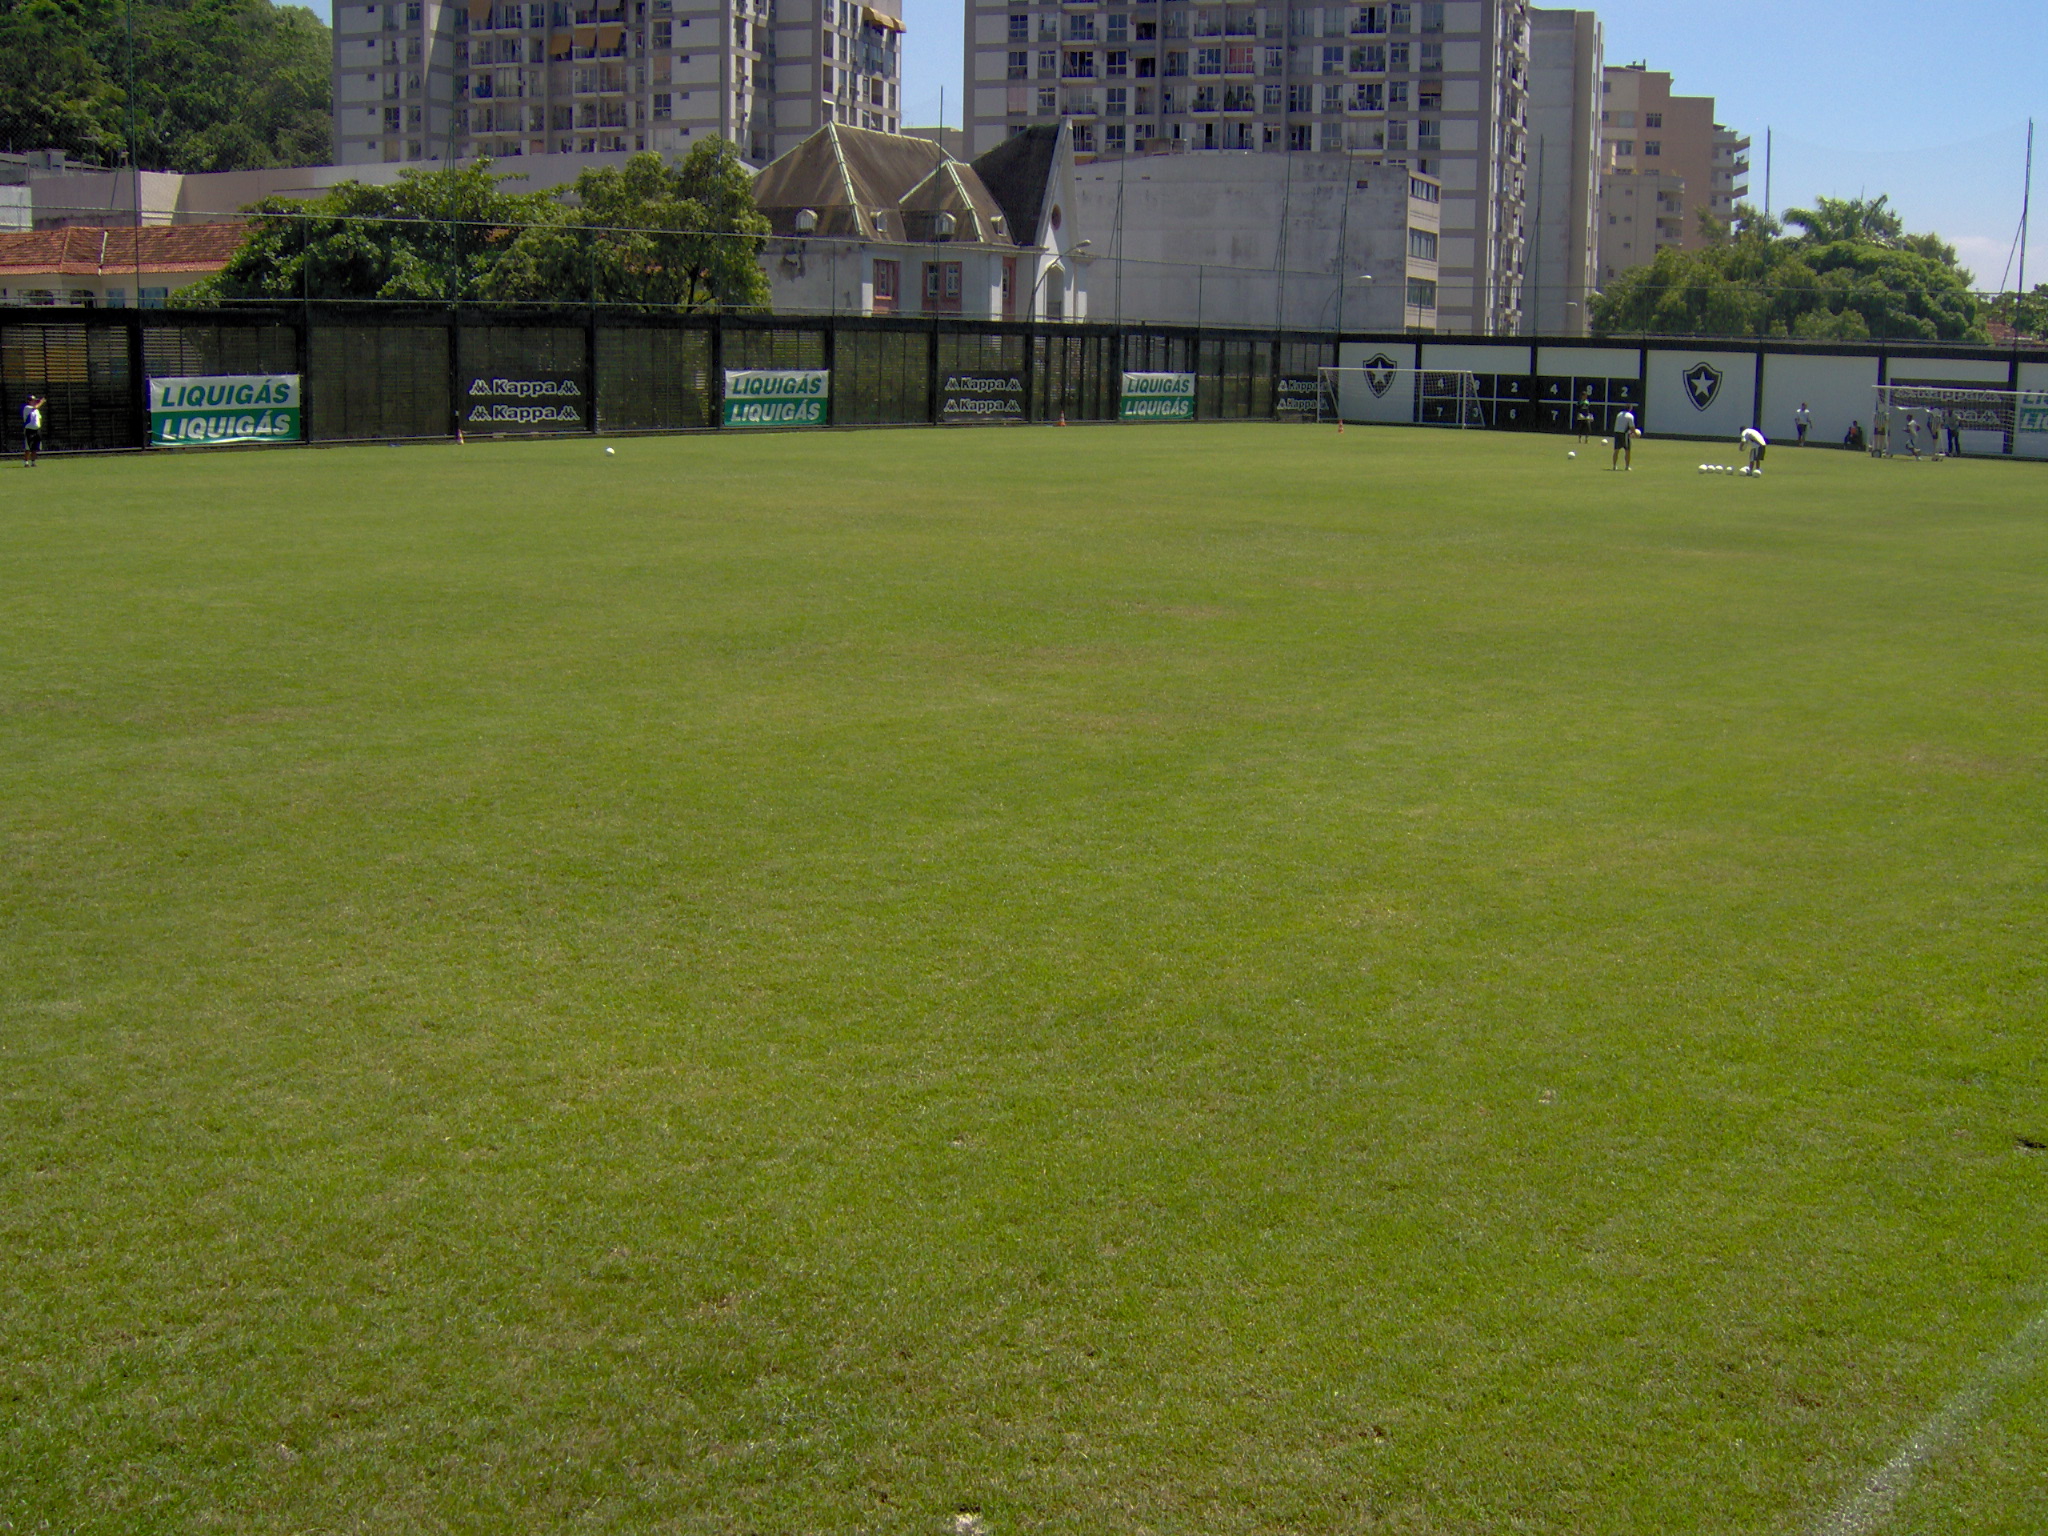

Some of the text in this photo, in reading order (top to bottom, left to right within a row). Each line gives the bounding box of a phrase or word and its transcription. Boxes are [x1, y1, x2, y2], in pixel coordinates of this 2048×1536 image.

[161, 379, 290, 407] LIQUIGÁS
[493, 379, 557, 397] Kappa
[732, 374, 821, 395] LIQUIGÁS
[961, 377, 1006, 393] Kappa
[1128, 375, 1190, 393] LIQUIGÁS
[1511, 382, 1518, 393] 2
[1550, 383, 1558, 395] 4
[1620, 386, 1628, 398] 2
[493, 405, 557, 423] Kappa
[731, 399, 820, 423] LIQUIGÁS
[960, 398, 1005, 414] Kappa
[1125, 397, 1189, 416] LIQUIGÁS
[1436, 407, 1443, 417] 7
[1551, 410, 1558, 420] 7
[162, 410, 291, 440] LIQUIGÁS
